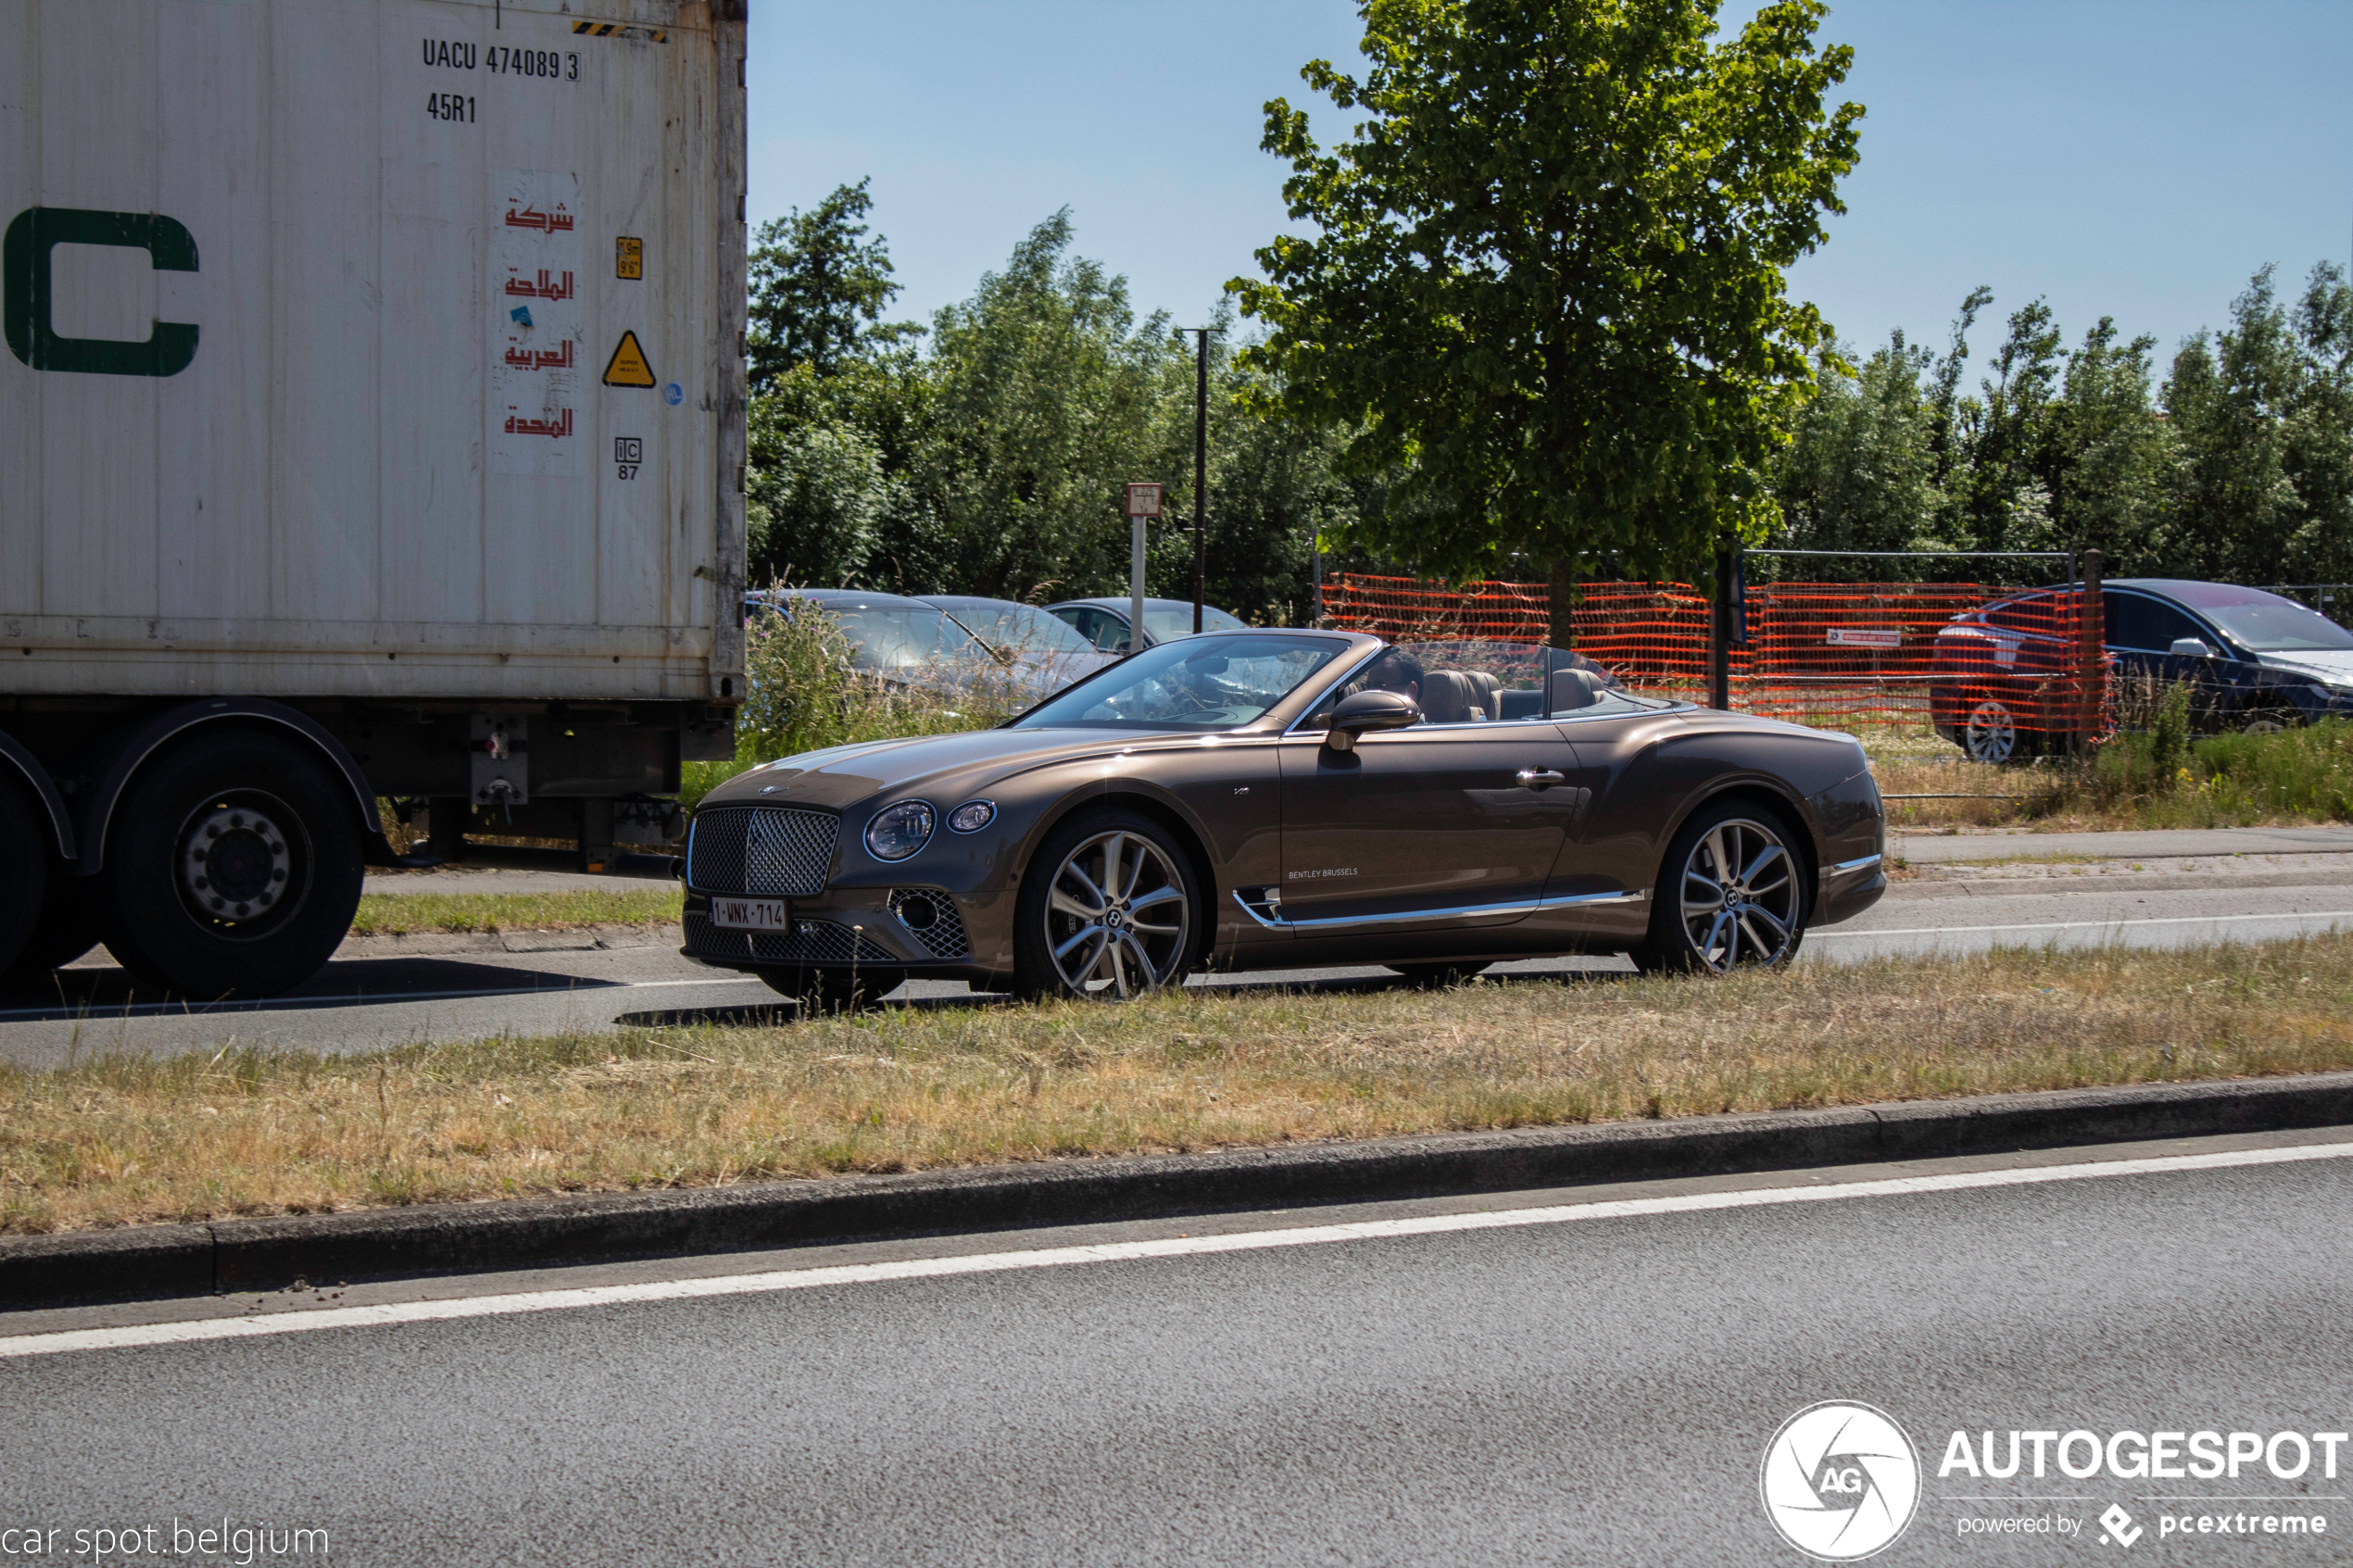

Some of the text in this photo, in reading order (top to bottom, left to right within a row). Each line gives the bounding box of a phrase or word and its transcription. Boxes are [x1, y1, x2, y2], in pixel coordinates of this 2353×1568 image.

[423, 39, 579, 81] UACU 474089 3
[427, 92, 475, 123] 45R1
[505, 197, 573, 234] شركة
[3, 207, 200, 378] C
[505, 267, 573, 301] الملاحة
[505, 336, 573, 370] العربية
[618, 465, 638, 481] 87
[1289, 868, 1358, 879] BENTLEY BRUSSELS
[714, 901, 783, 925] 1-WNX-714
